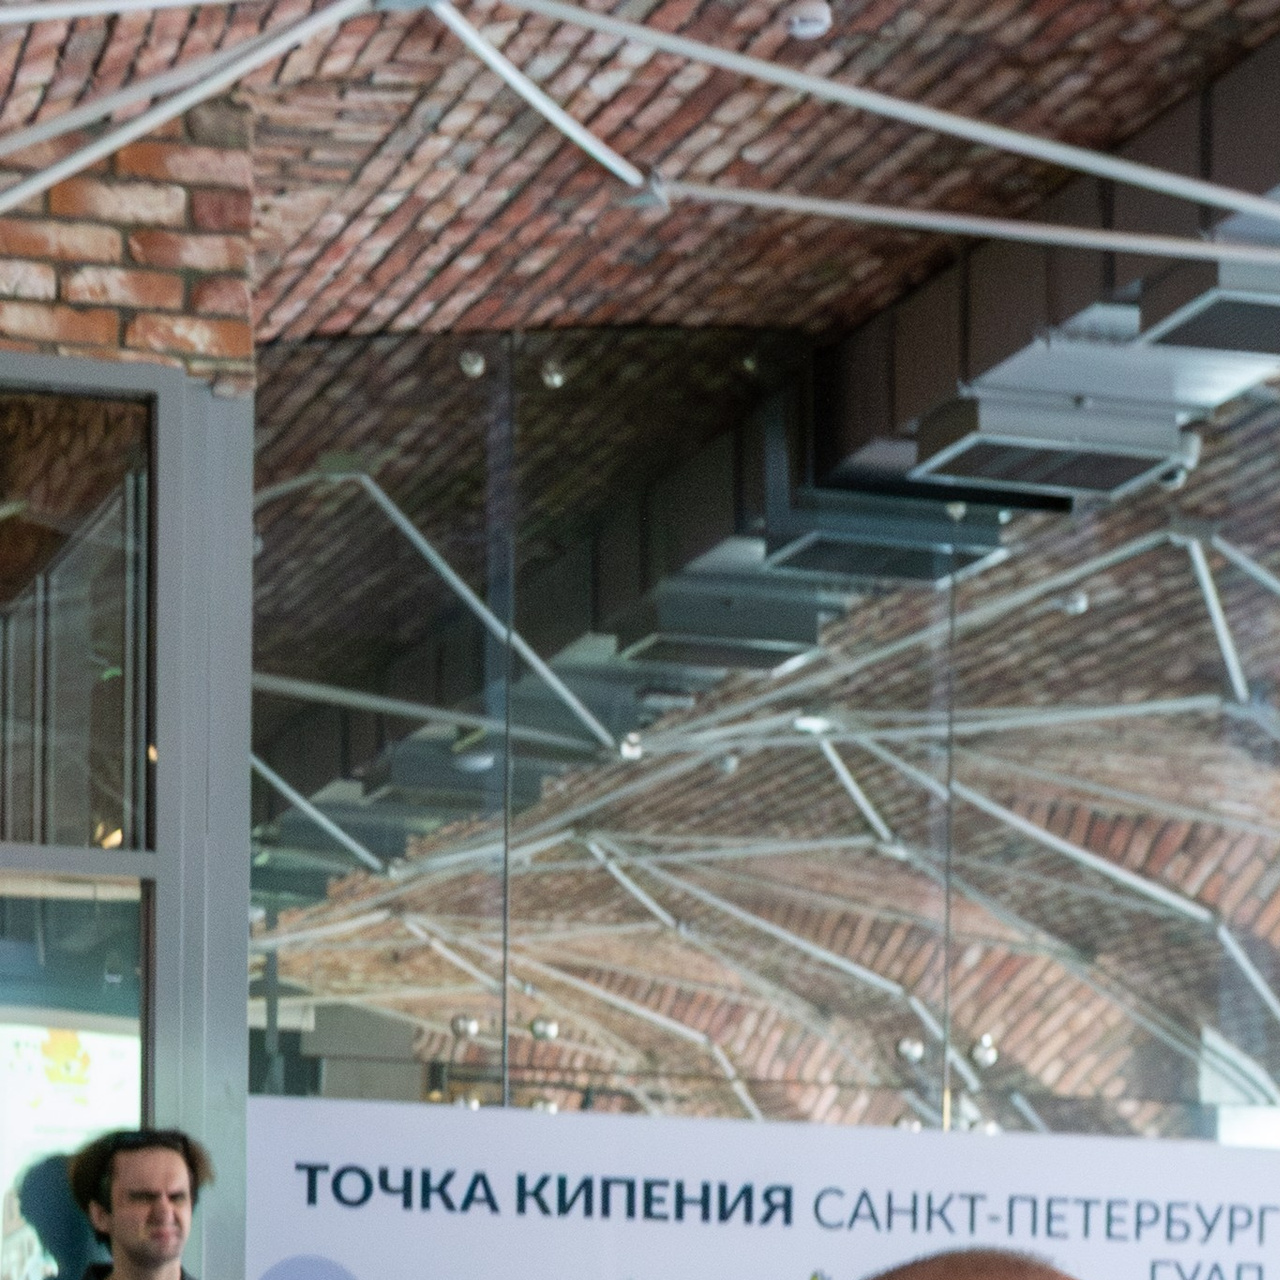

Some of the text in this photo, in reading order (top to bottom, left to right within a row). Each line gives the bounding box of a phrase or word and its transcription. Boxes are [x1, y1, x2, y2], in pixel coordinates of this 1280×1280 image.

[294, 1162, 1280, 1246] ТОЧКА КИПЕНИЯ САНКТ-ПЕТЕРБУРГ
